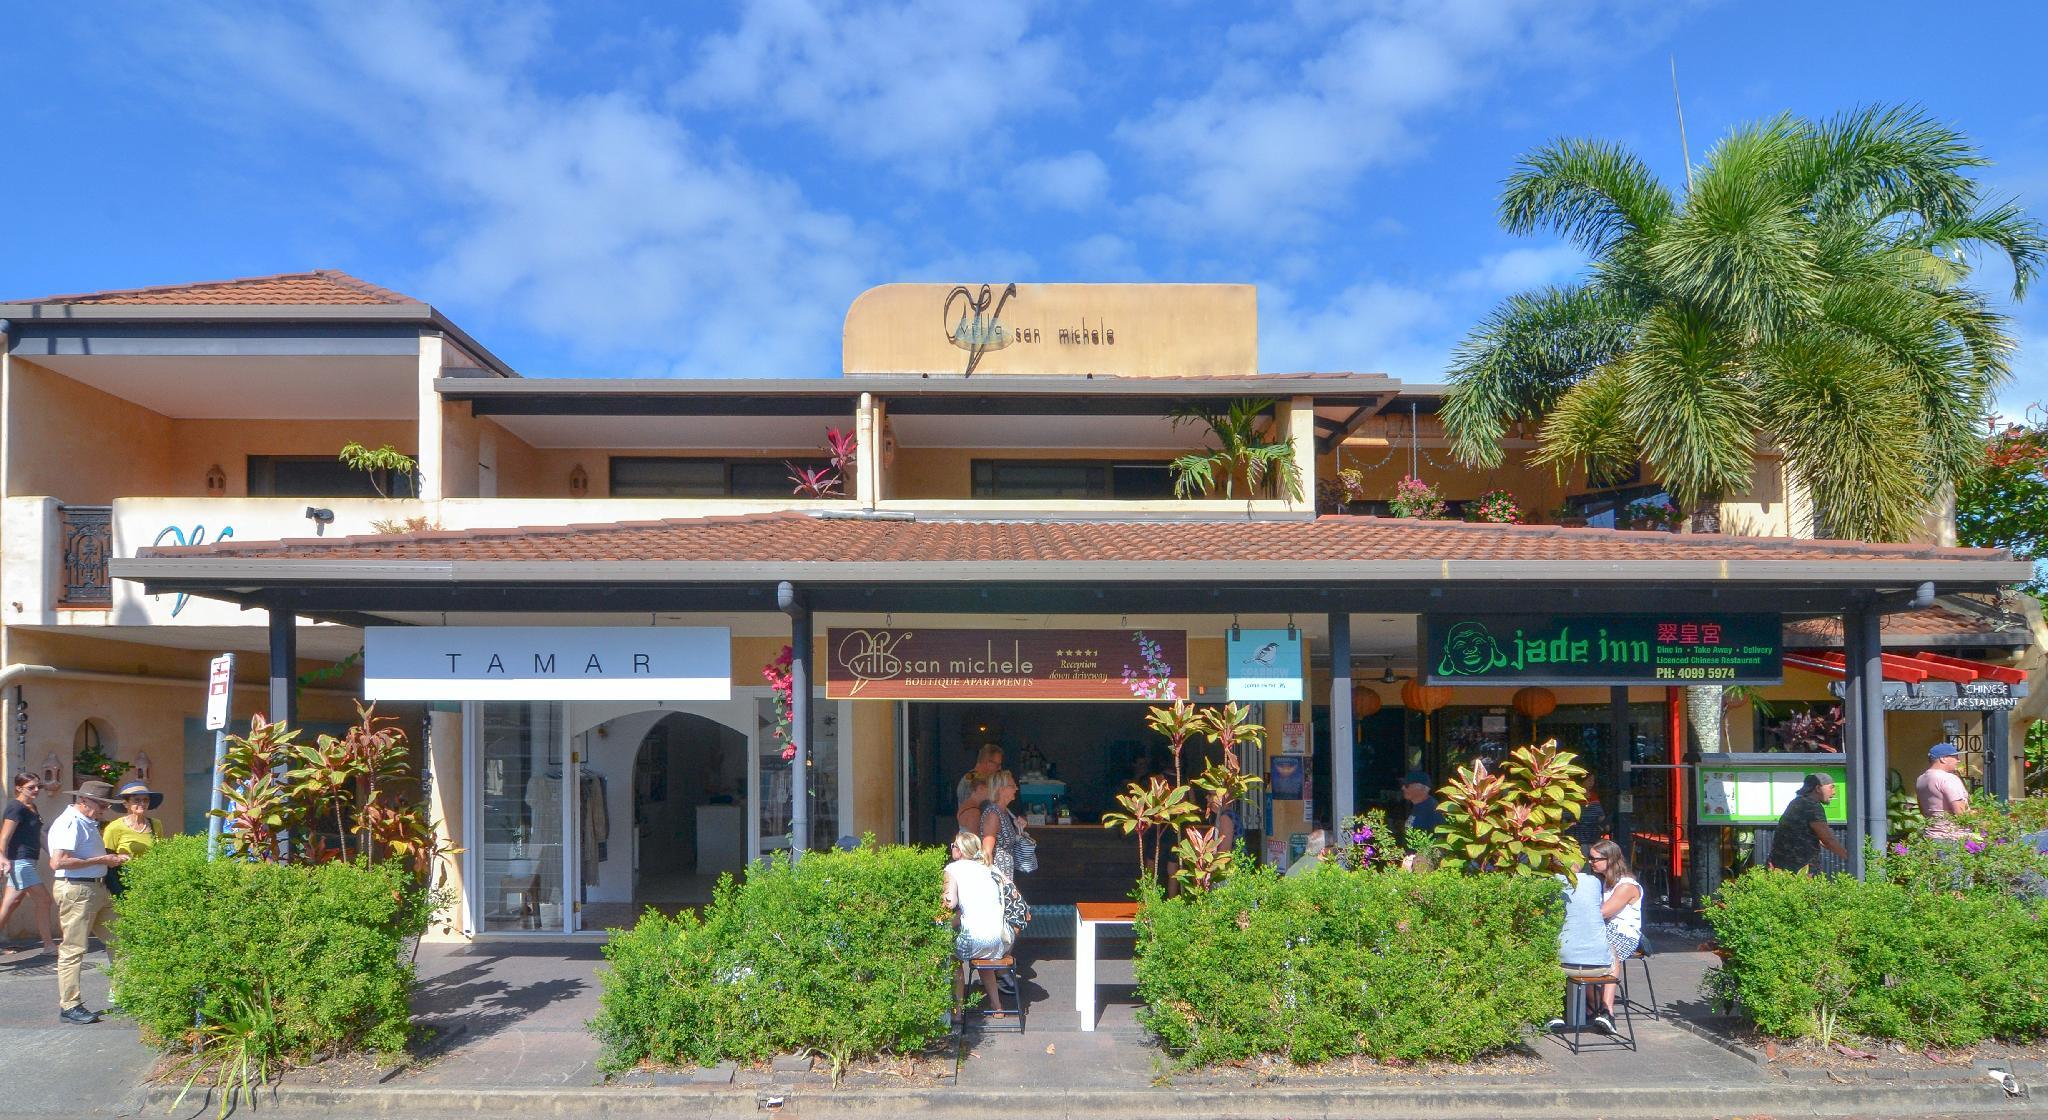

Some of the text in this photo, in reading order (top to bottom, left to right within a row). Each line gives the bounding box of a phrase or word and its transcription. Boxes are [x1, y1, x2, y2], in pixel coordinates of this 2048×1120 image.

[1015, 326, 1041, 343] san
[1058, 317, 1115, 345] michele
[1657, 623, 1721, 644] 翠皇宮
[1510, 626, 1649, 670] jade inn
[1656, 646, 1674, 655] Dine
[1693, 646, 1712, 655] Take
[1712, 646, 1733, 656] Away
[1743, 646, 1773, 656] Delivery
[854, 639, 1034, 674] villa san michele
[1690, 656, 1720, 665] Chinese
[1721, 656, 1761, 665] Restaurant
[445, 653, 651, 674] TAMAR
[1060, 659, 1098, 672] Reception
[1049, 670, 1108, 684] down driveway
[1656, 667, 1735, 679] PH: 4099 5974
[905, 677, 1034, 688] BOUTIQUE APARTMENTS
[1965, 684, 2010, 695] CHINESE
[1957, 697, 2019, 708] RESTAURANT
